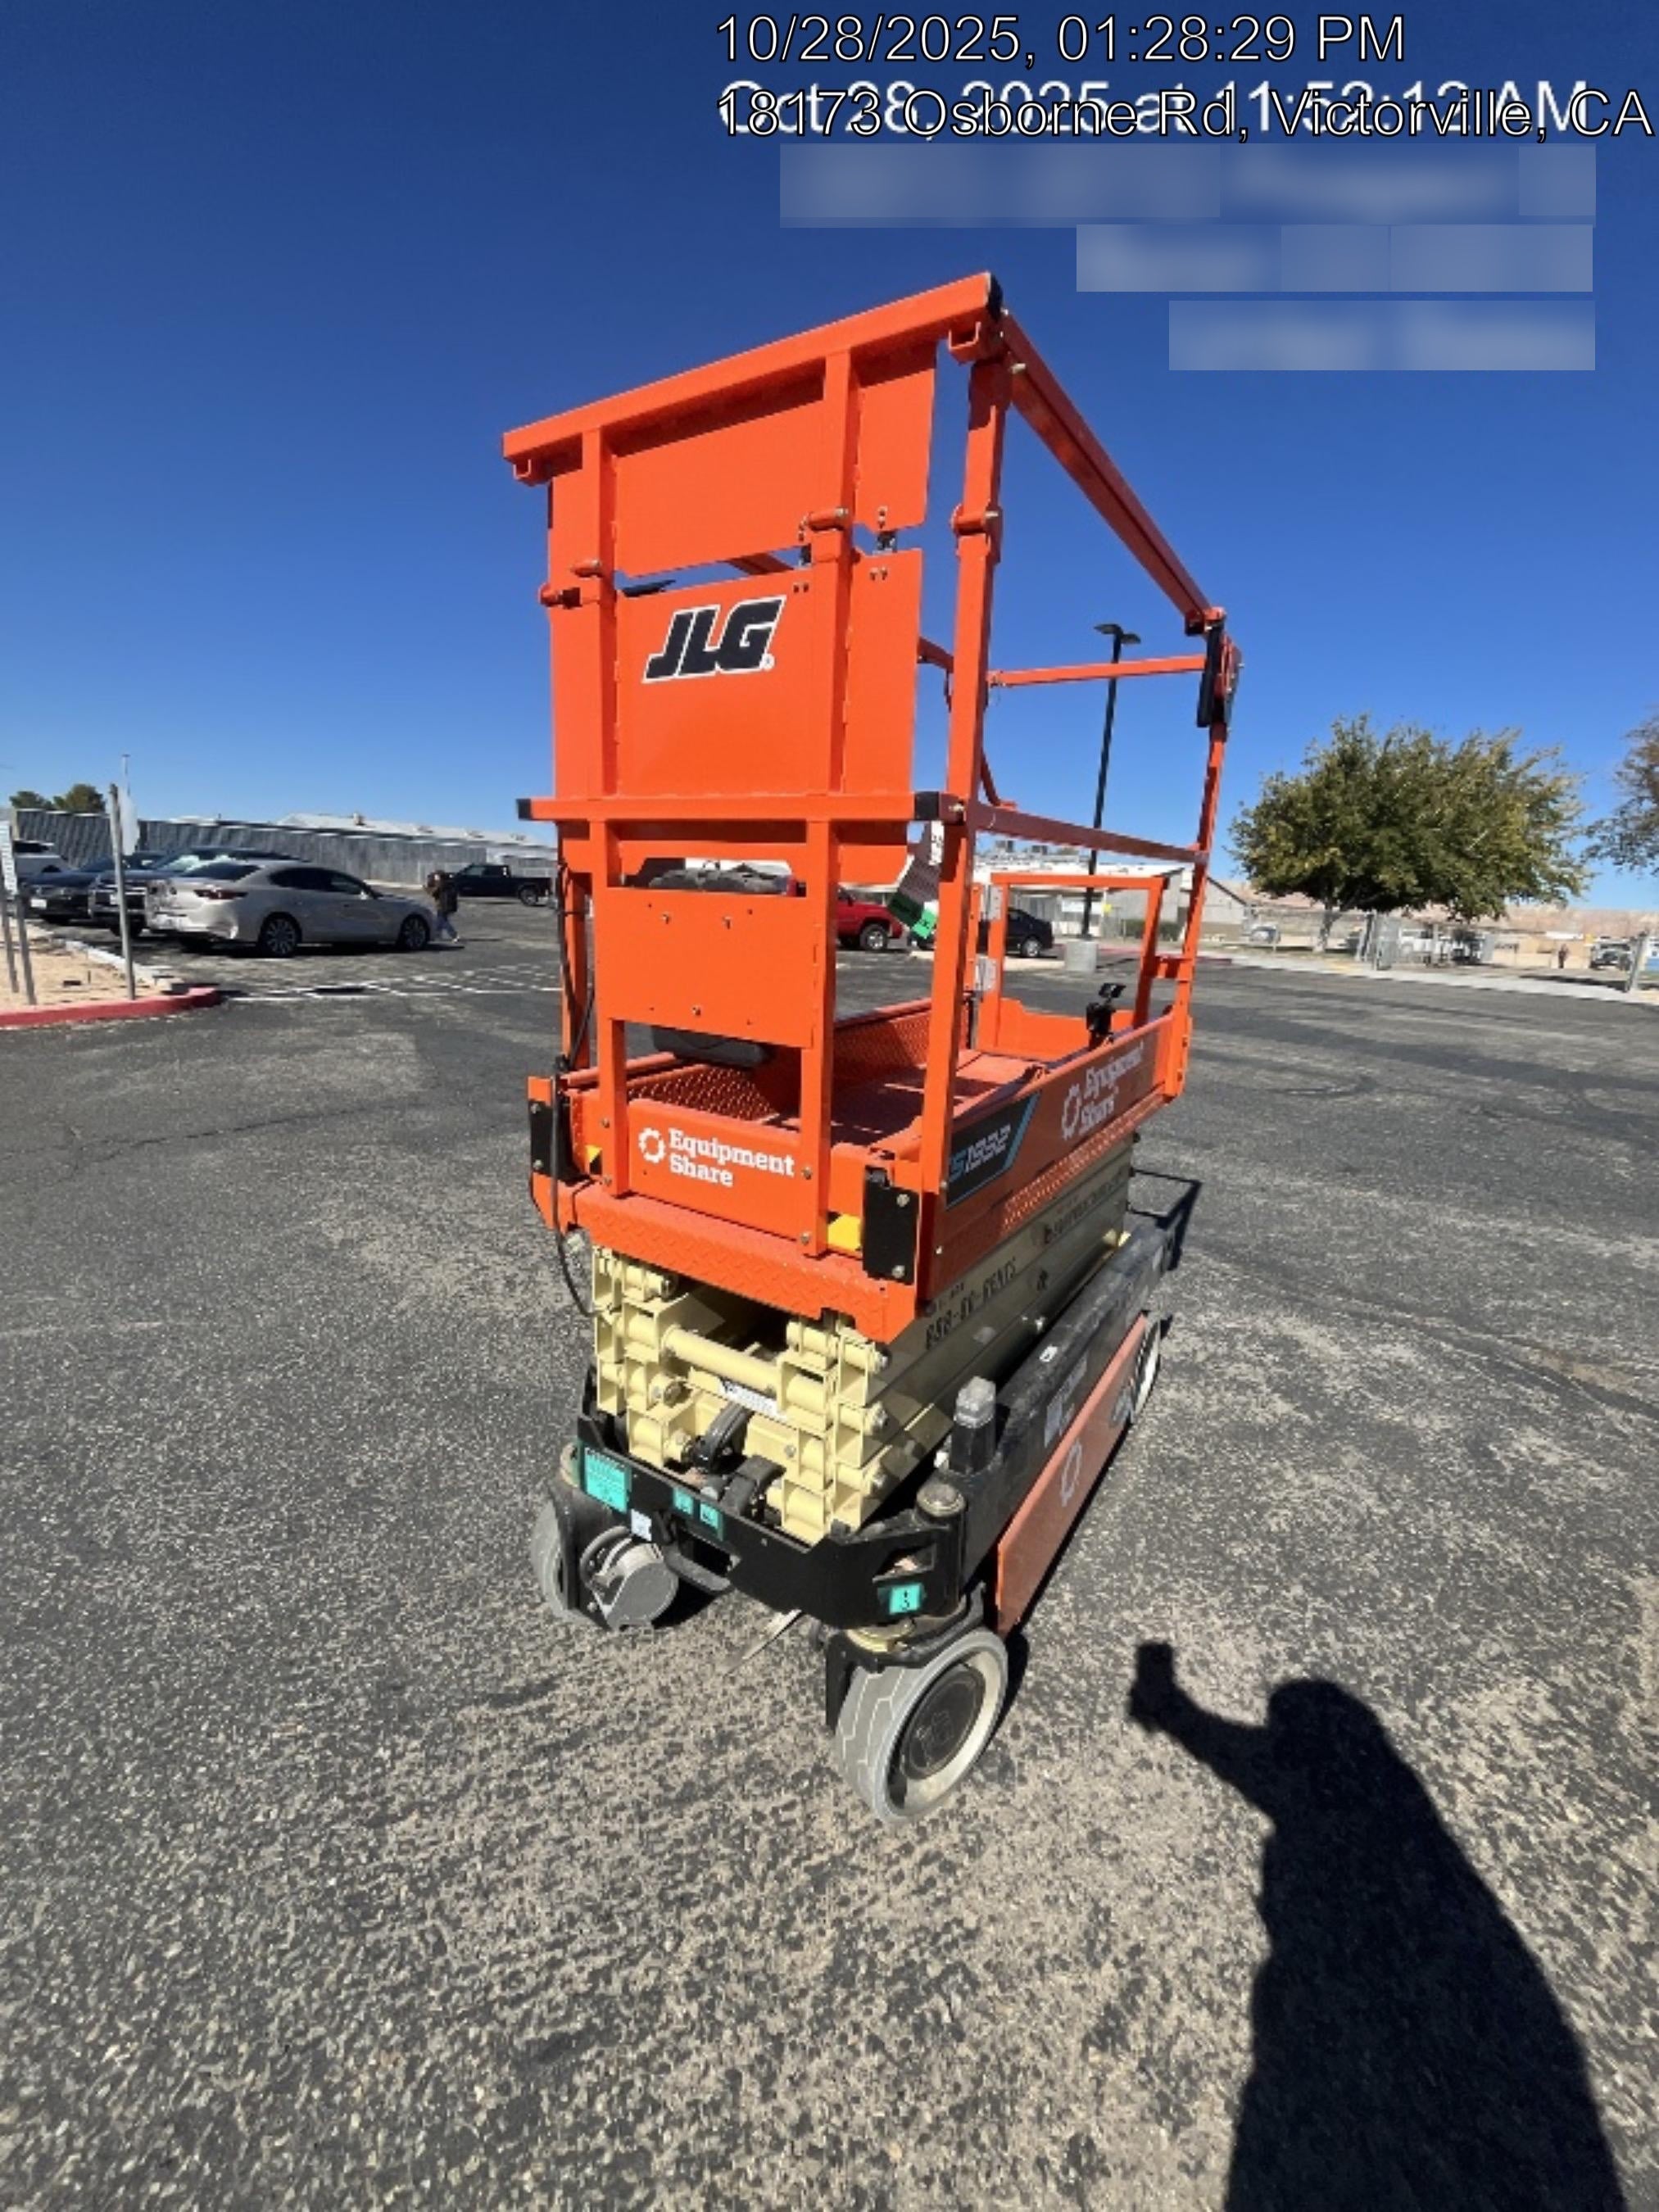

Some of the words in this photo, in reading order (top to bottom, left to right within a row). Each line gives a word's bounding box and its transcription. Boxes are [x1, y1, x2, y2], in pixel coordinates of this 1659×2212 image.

[642, 596, 786, 682] JLG
[669, 1127, 795, 1177] Equipment
[669, 1152, 734, 1187] Share
